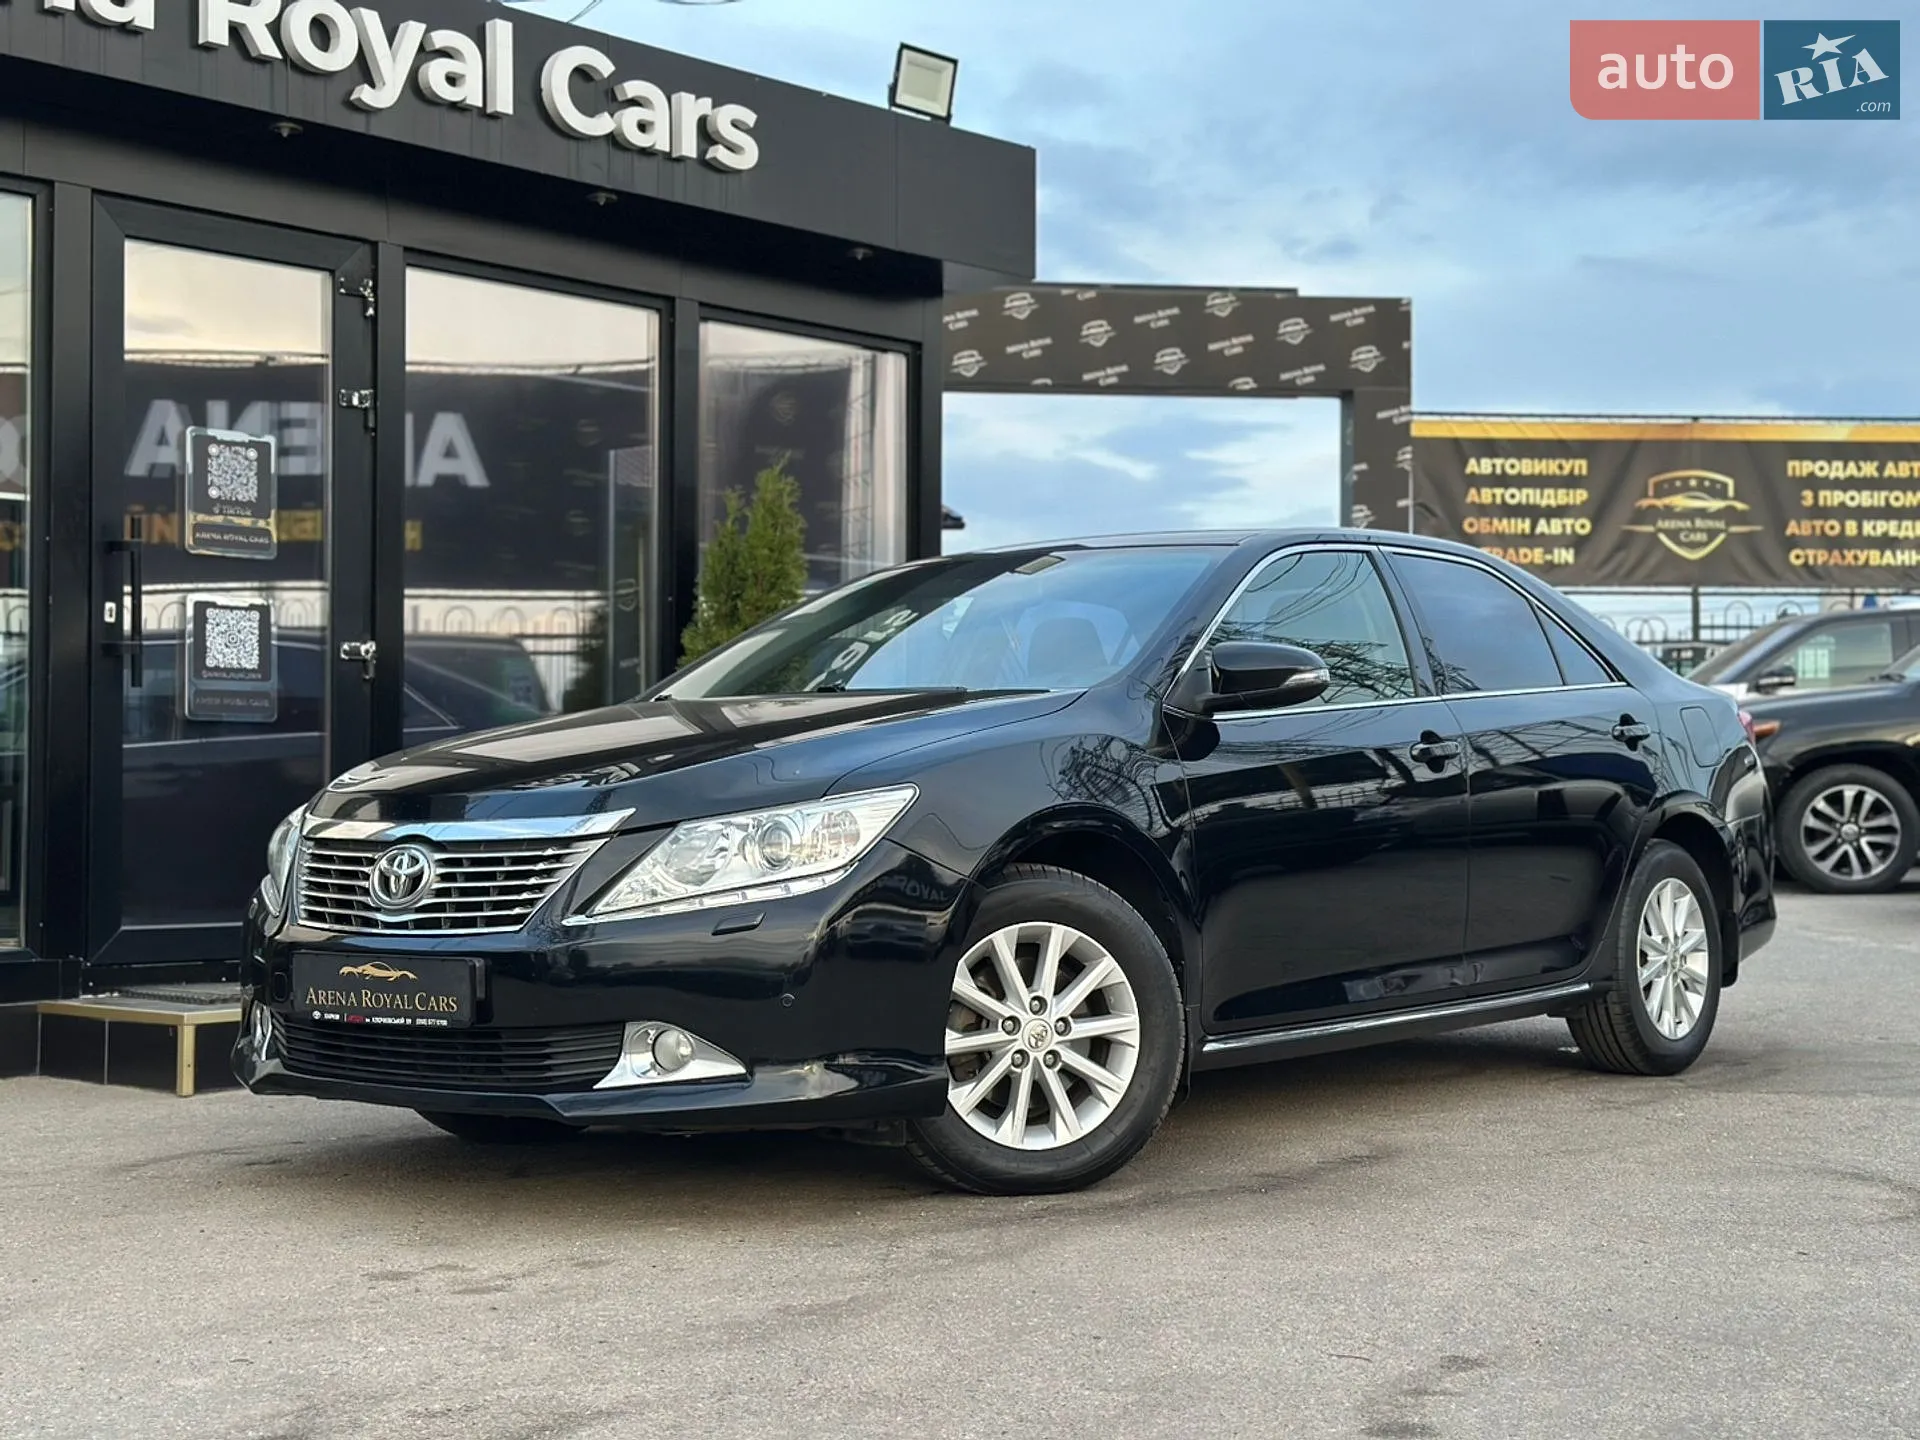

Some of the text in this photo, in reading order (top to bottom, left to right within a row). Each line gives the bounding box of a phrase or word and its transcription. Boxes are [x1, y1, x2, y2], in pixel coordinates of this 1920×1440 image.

[198, 0, 761, 171] Royal Cars
[1464, 457, 1589, 476] АВТОВИКУП
[1786, 460, 1879, 480] ПРОДАЖ
[1465, 487, 1589, 508] АВТОПІДБІР
[1801, 489, 1920, 508] З ПРОБІГОМ
[1462, 517, 1592, 535] ОБМІН АВТО
[1785, 519, 1842, 537] АВТО
[1844, 519, 1859, 537] В
[305, 986, 458, 1012] ARENA ROYAL CARS
